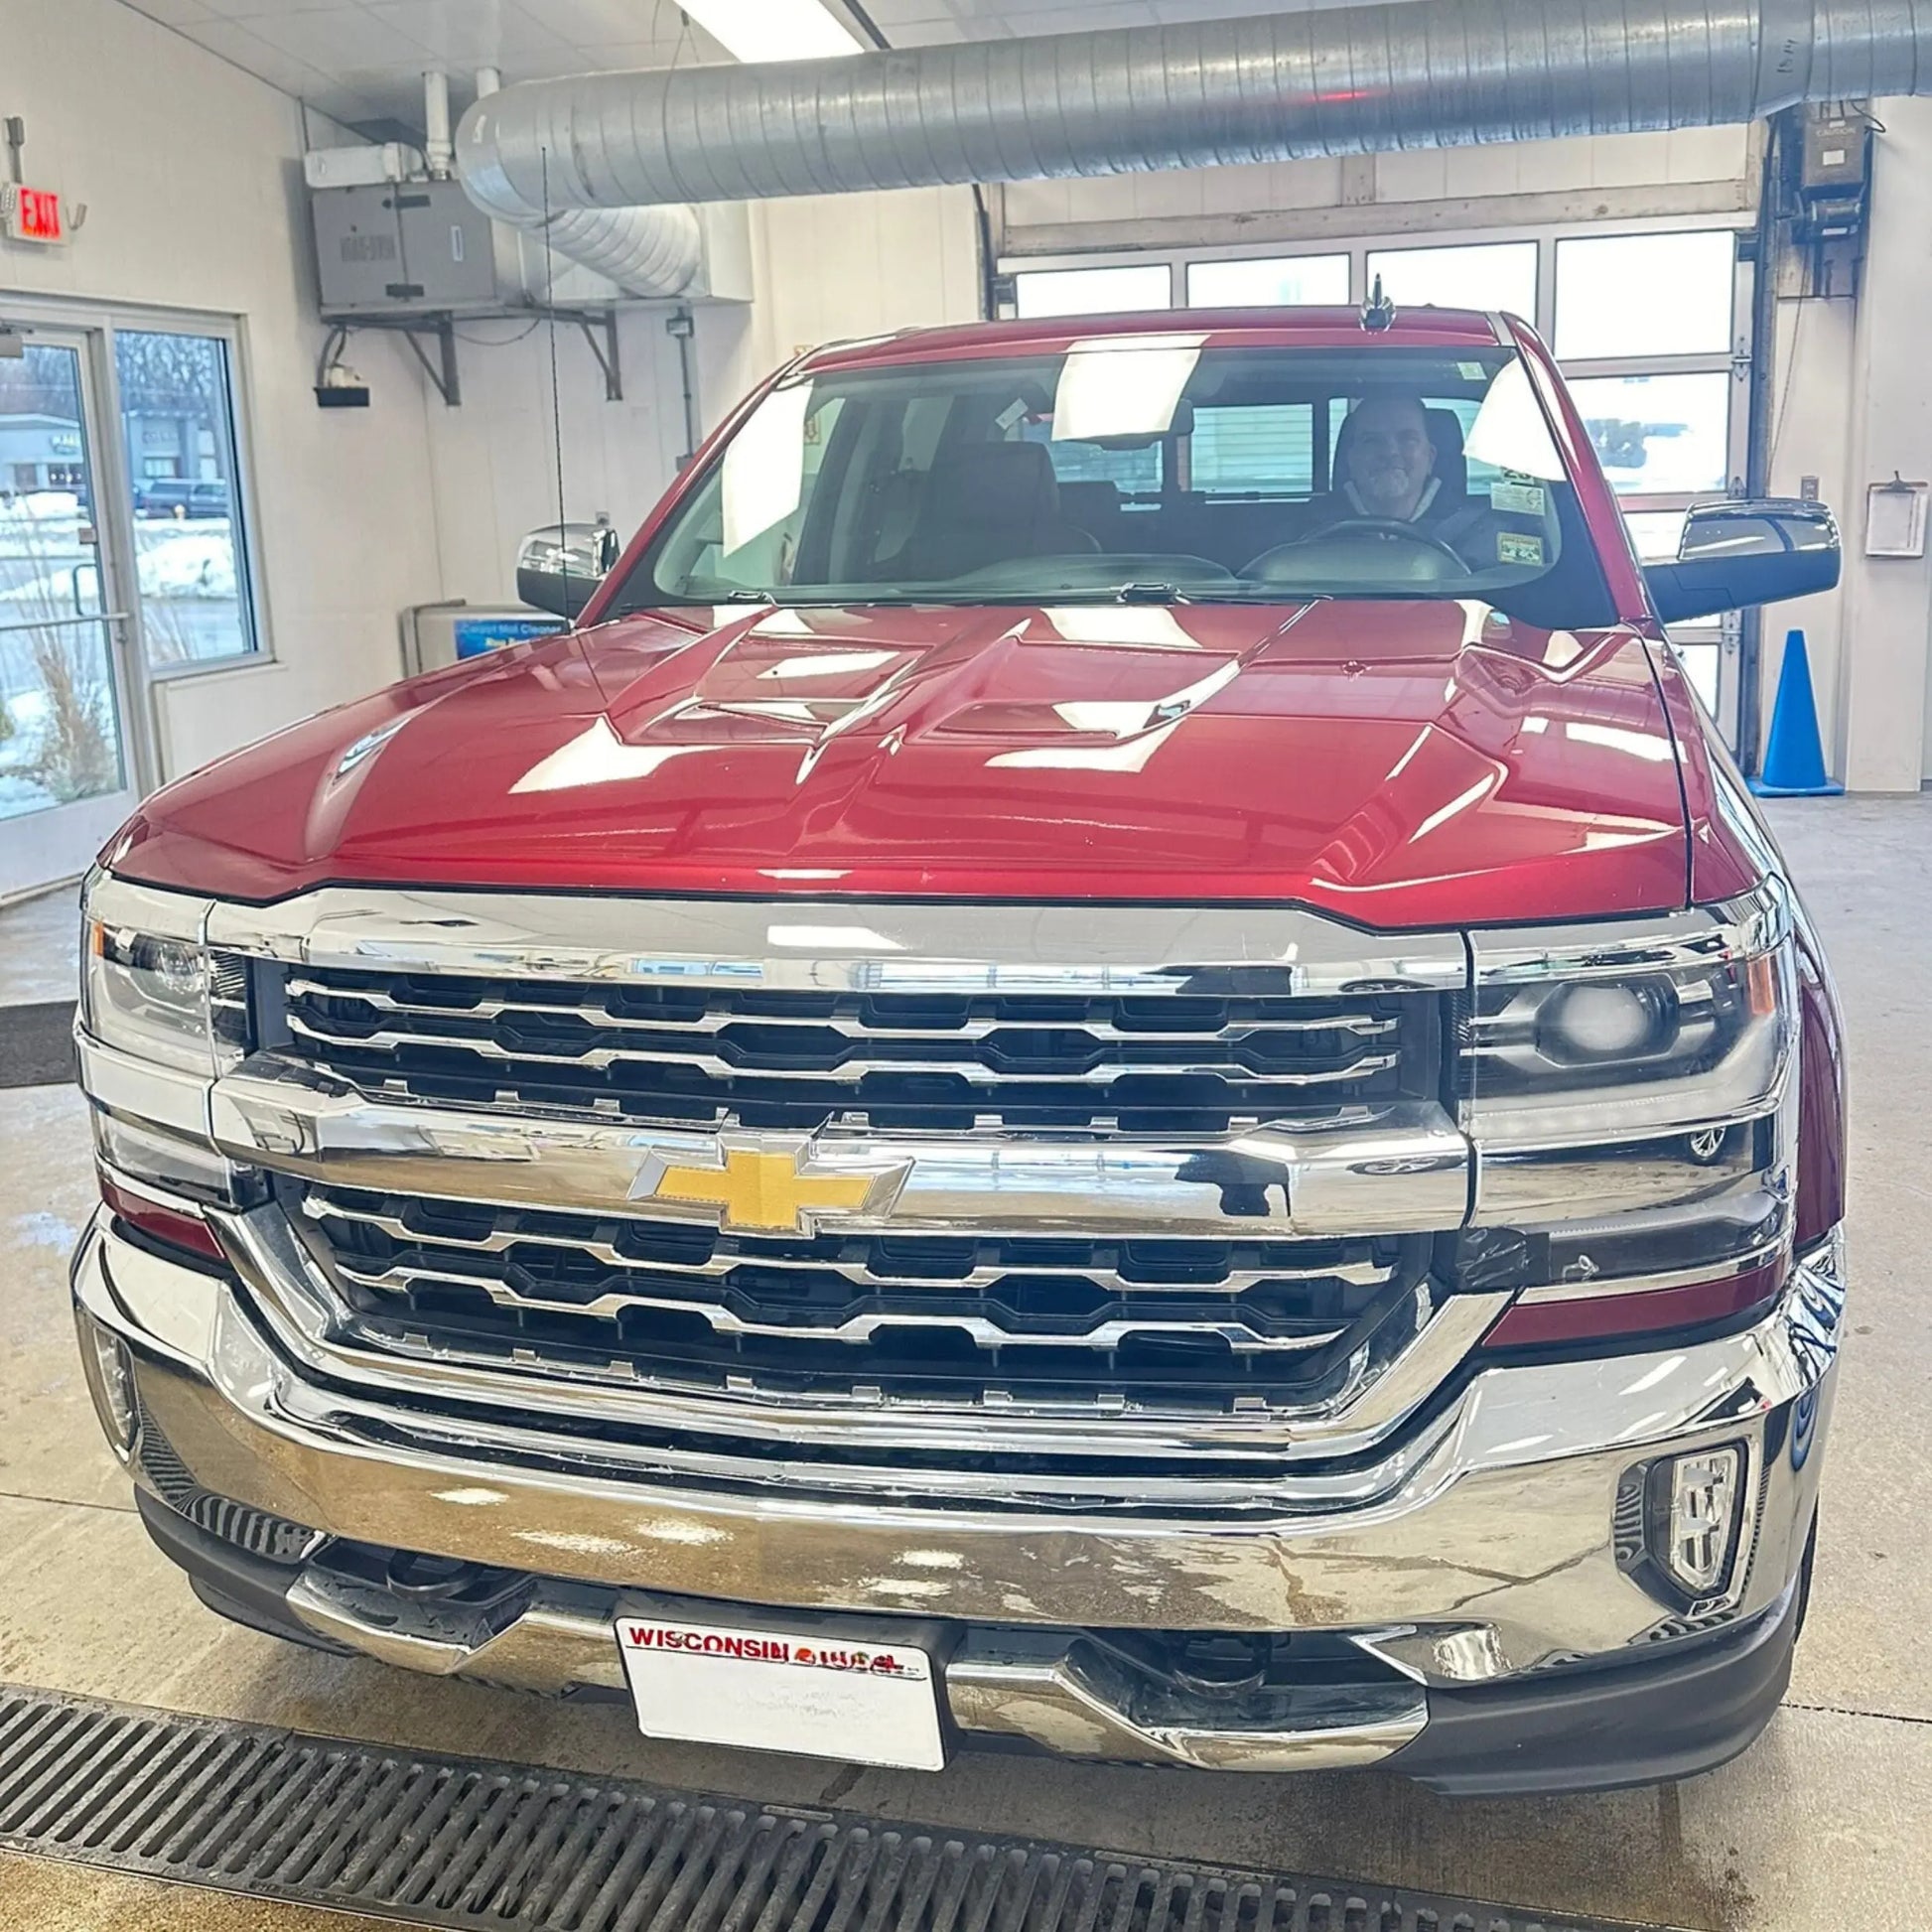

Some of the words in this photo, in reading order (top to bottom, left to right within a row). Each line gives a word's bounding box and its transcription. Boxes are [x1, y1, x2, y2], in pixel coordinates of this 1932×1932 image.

[1815, 126, 1858, 137] CAUTION
[20, 189, 60, 238] EXIT
[520, 623, 562, 634] Cleaner
[628, 1627, 789, 1662] WISCONSIN
